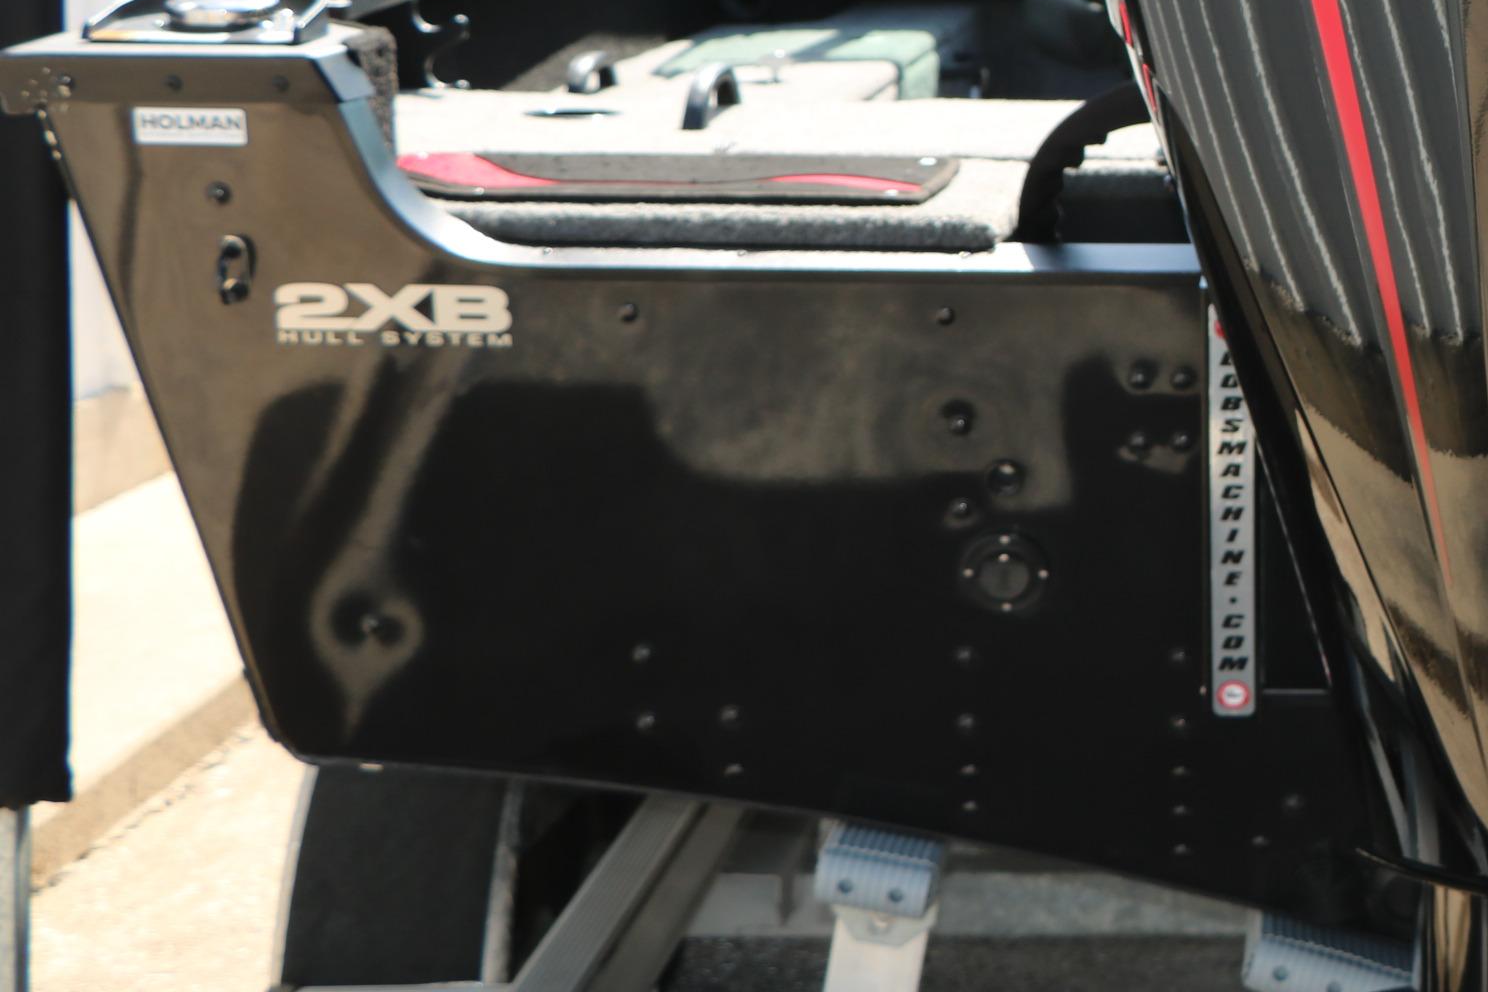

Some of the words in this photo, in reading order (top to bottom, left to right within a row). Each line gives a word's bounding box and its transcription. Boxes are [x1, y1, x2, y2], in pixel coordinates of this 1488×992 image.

[141, 115, 241, 129] HOLMAN
[274, 282, 513, 332] 2XB
[277, 330, 364, 346] HULL
[381, 330, 513, 347] SYSTEM
